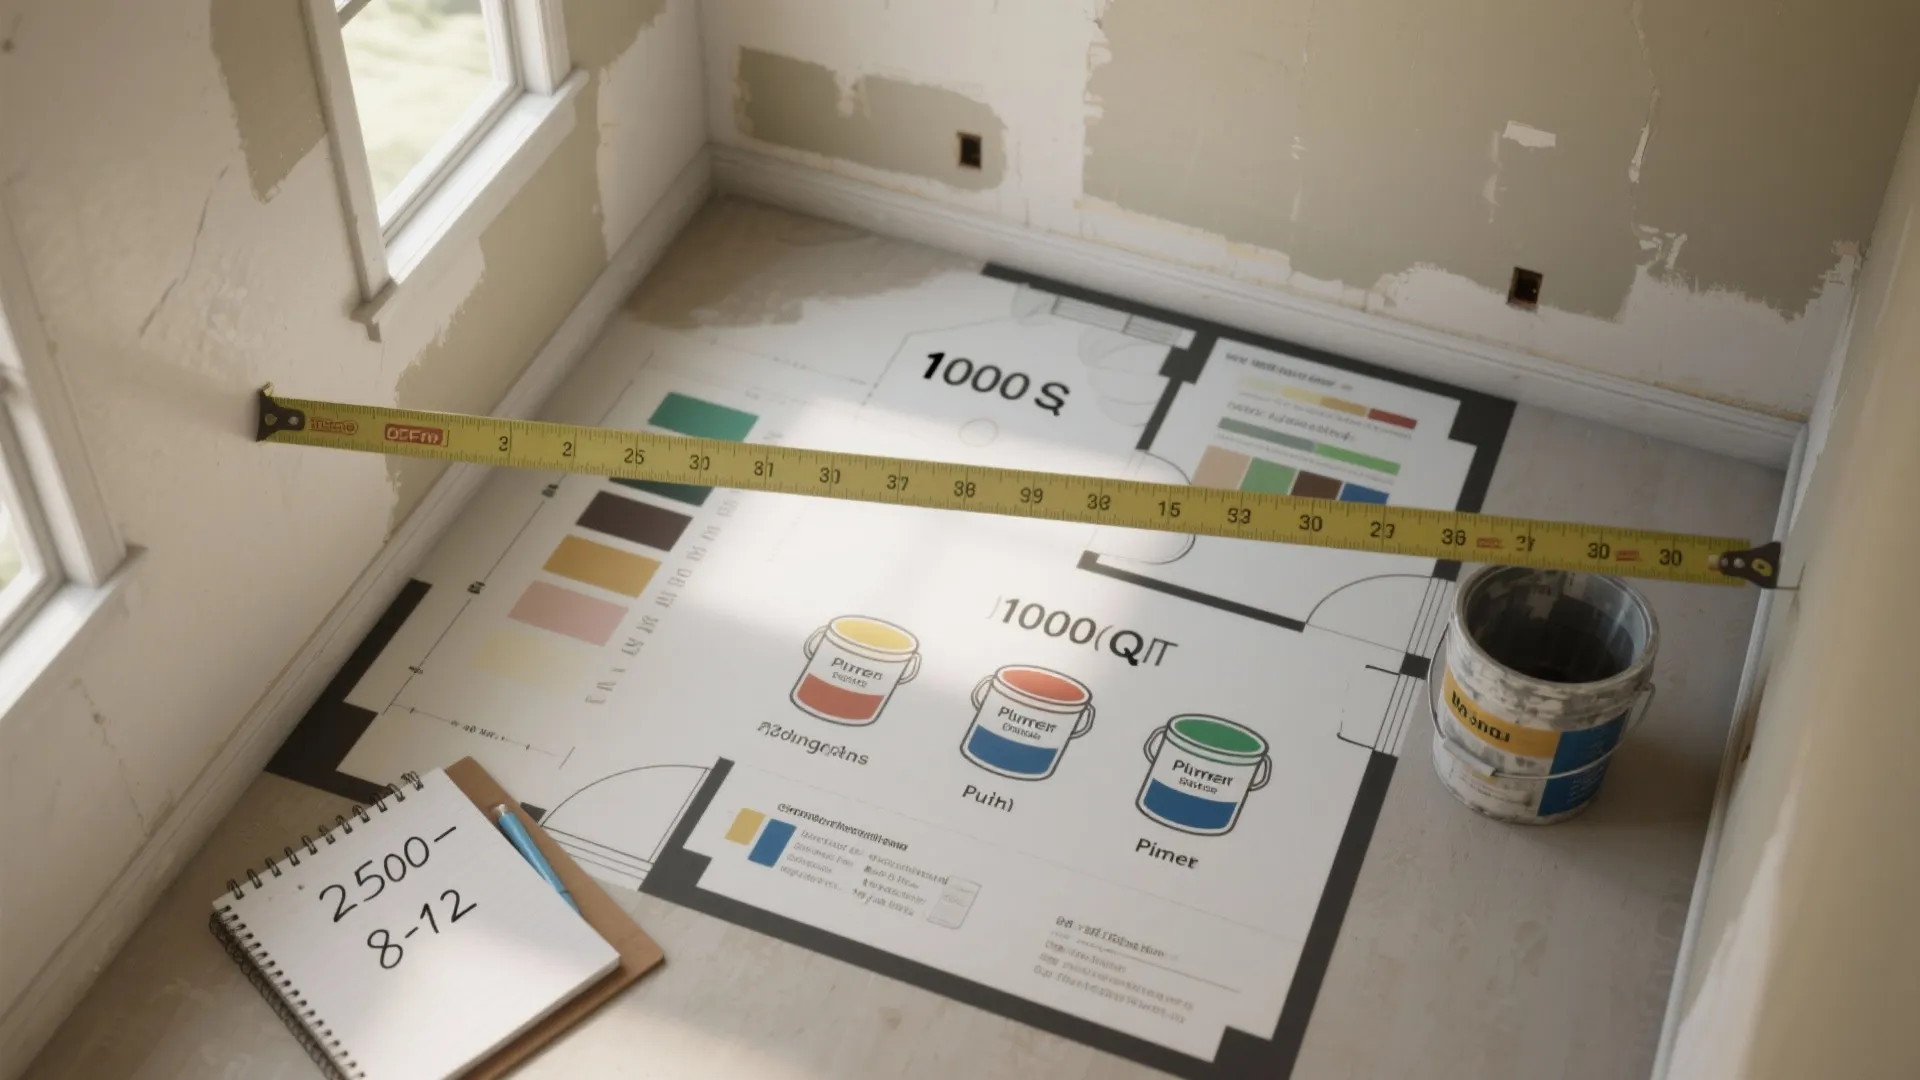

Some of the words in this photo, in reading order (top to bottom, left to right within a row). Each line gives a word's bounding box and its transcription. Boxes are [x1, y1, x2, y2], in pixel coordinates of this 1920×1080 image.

[923, 352, 1030, 401] 1000
[562, 441, 572, 456] 2
[886, 475, 909, 491] 37
[1158, 501, 1180, 518] 15
[1298, 514, 1323, 532] 30
[1587, 543, 1610, 560] 30
[1659, 549, 1682, 566] 30
[1135, 838, 1199, 869] Pimer
[367, 889, 477, 969] 8-12
